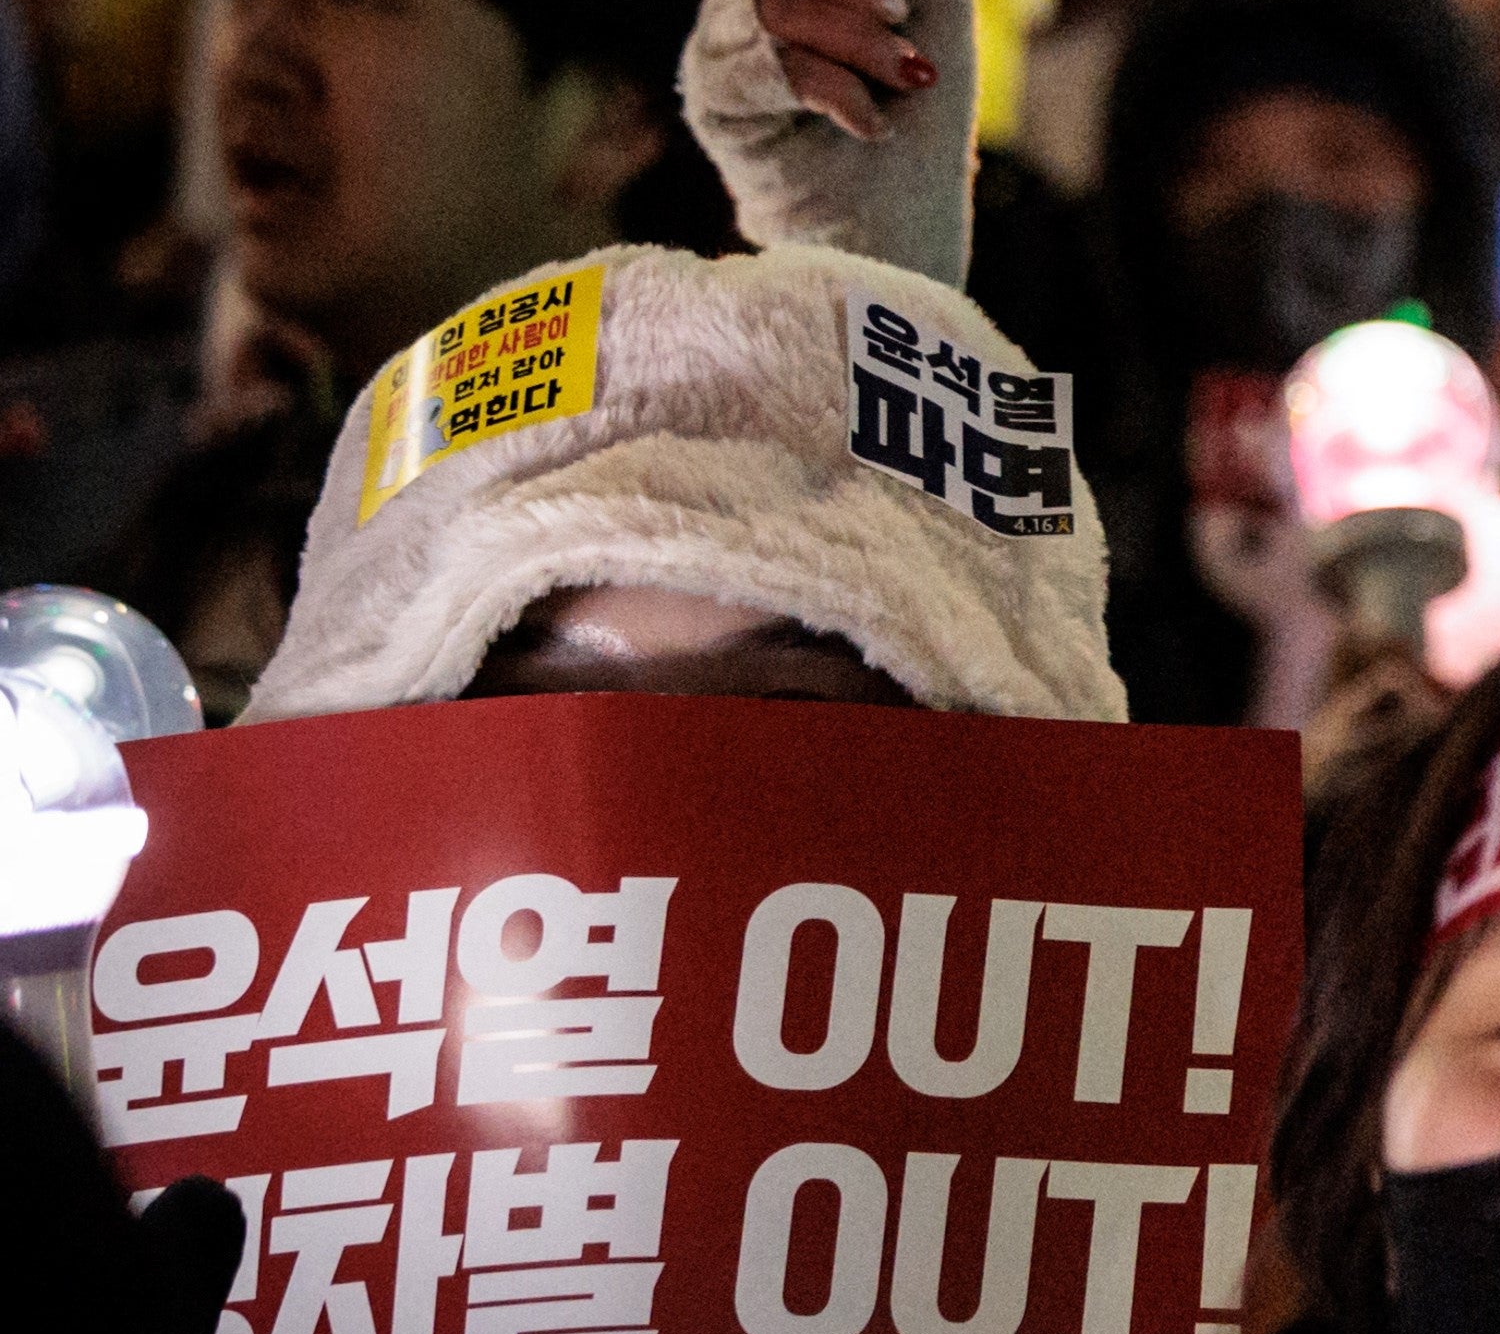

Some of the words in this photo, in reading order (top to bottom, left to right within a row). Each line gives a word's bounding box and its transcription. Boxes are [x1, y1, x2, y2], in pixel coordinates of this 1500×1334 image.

[478, 281, 574, 337] 침공시
[498, 312, 570, 357] 사람이
[454, 366, 501, 403] 먼저
[512, 347, 566, 380] 잡아
[862, 303, 1057, 434] 윤석열
[450, 378, 562, 437] 먹힌다
[851, 361, 1073, 536] 파면
[1014, 517, 1054, 534] 4.16
[93, 874, 680, 1148] 윤석열
[733, 882, 1254, 1115] OUT!
